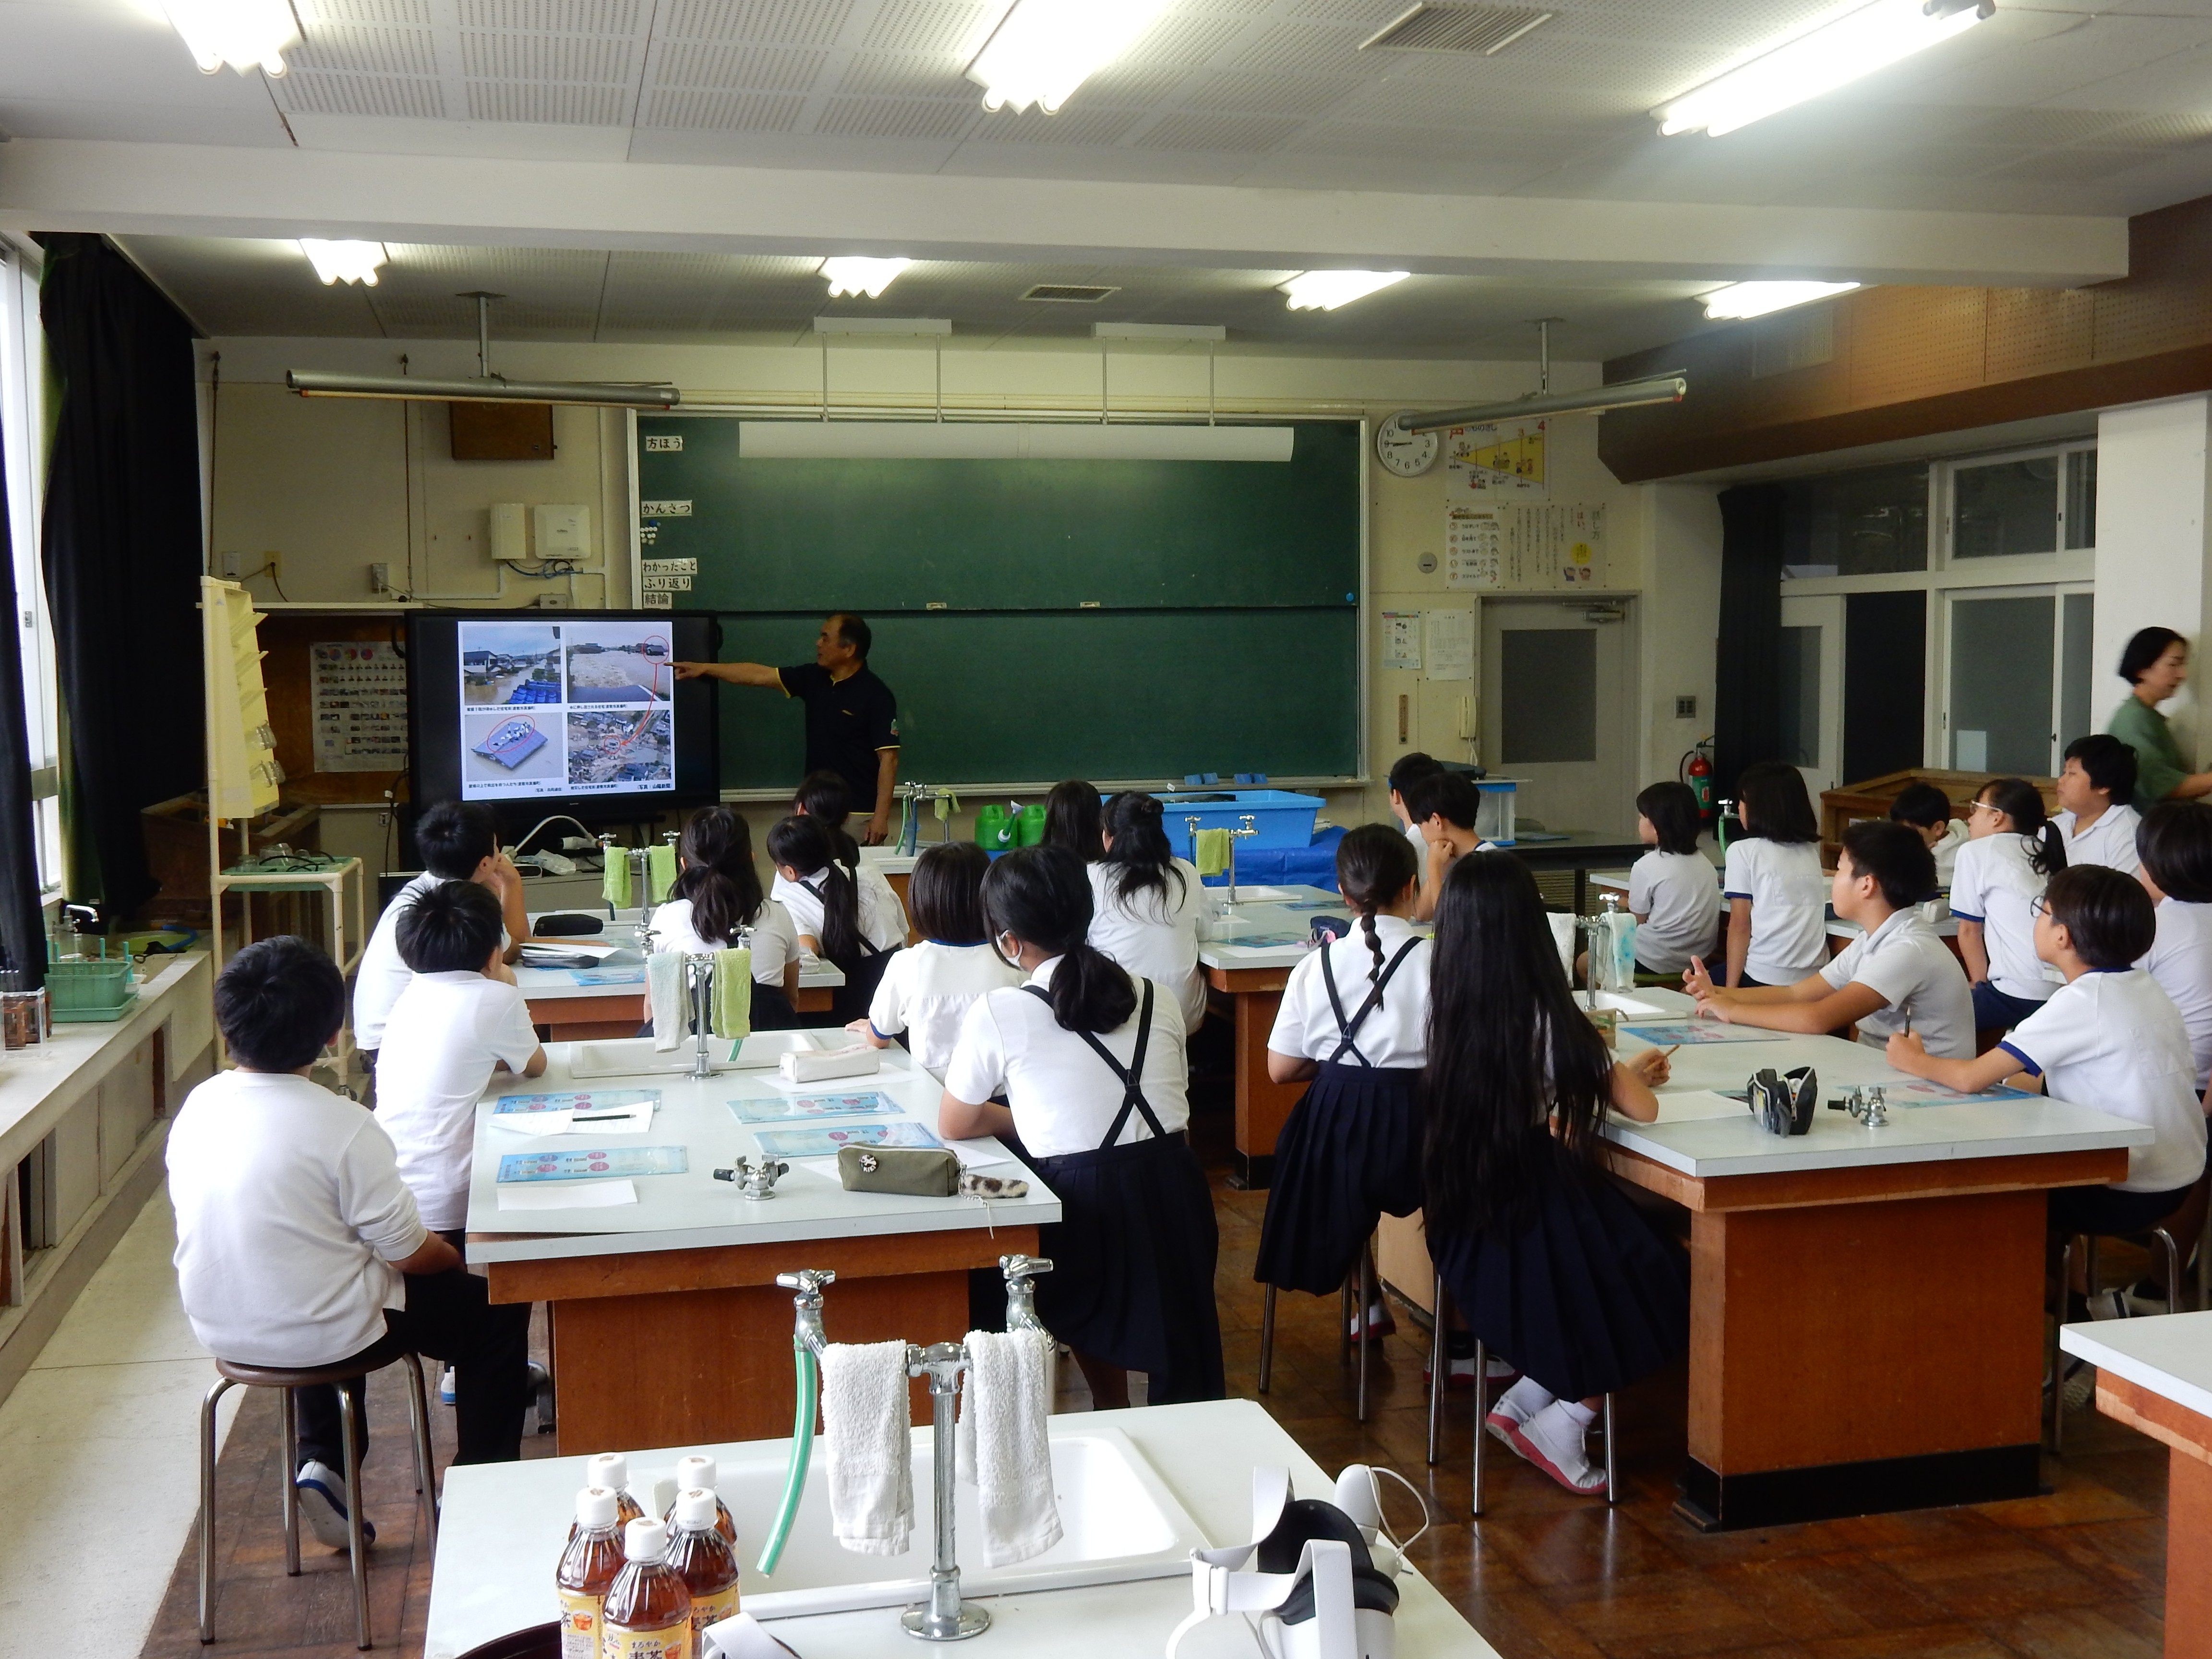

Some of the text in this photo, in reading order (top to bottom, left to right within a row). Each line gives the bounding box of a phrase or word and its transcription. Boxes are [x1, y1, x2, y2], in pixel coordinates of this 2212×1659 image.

[1386, 429, 1394, 438] 10
[647, 438, 680, 449] 方ほう
[1384, 440, 1389, 448] 9
[1425, 440, 1430, 448] 3
[1405, 461, 1410, 470] 6
[643, 503, 690, 514] かんさつ
[643, 561, 696, 572] わかったこと
[645, 578, 689, 589] ふり返り
[645, 593, 669, 605] 結論
